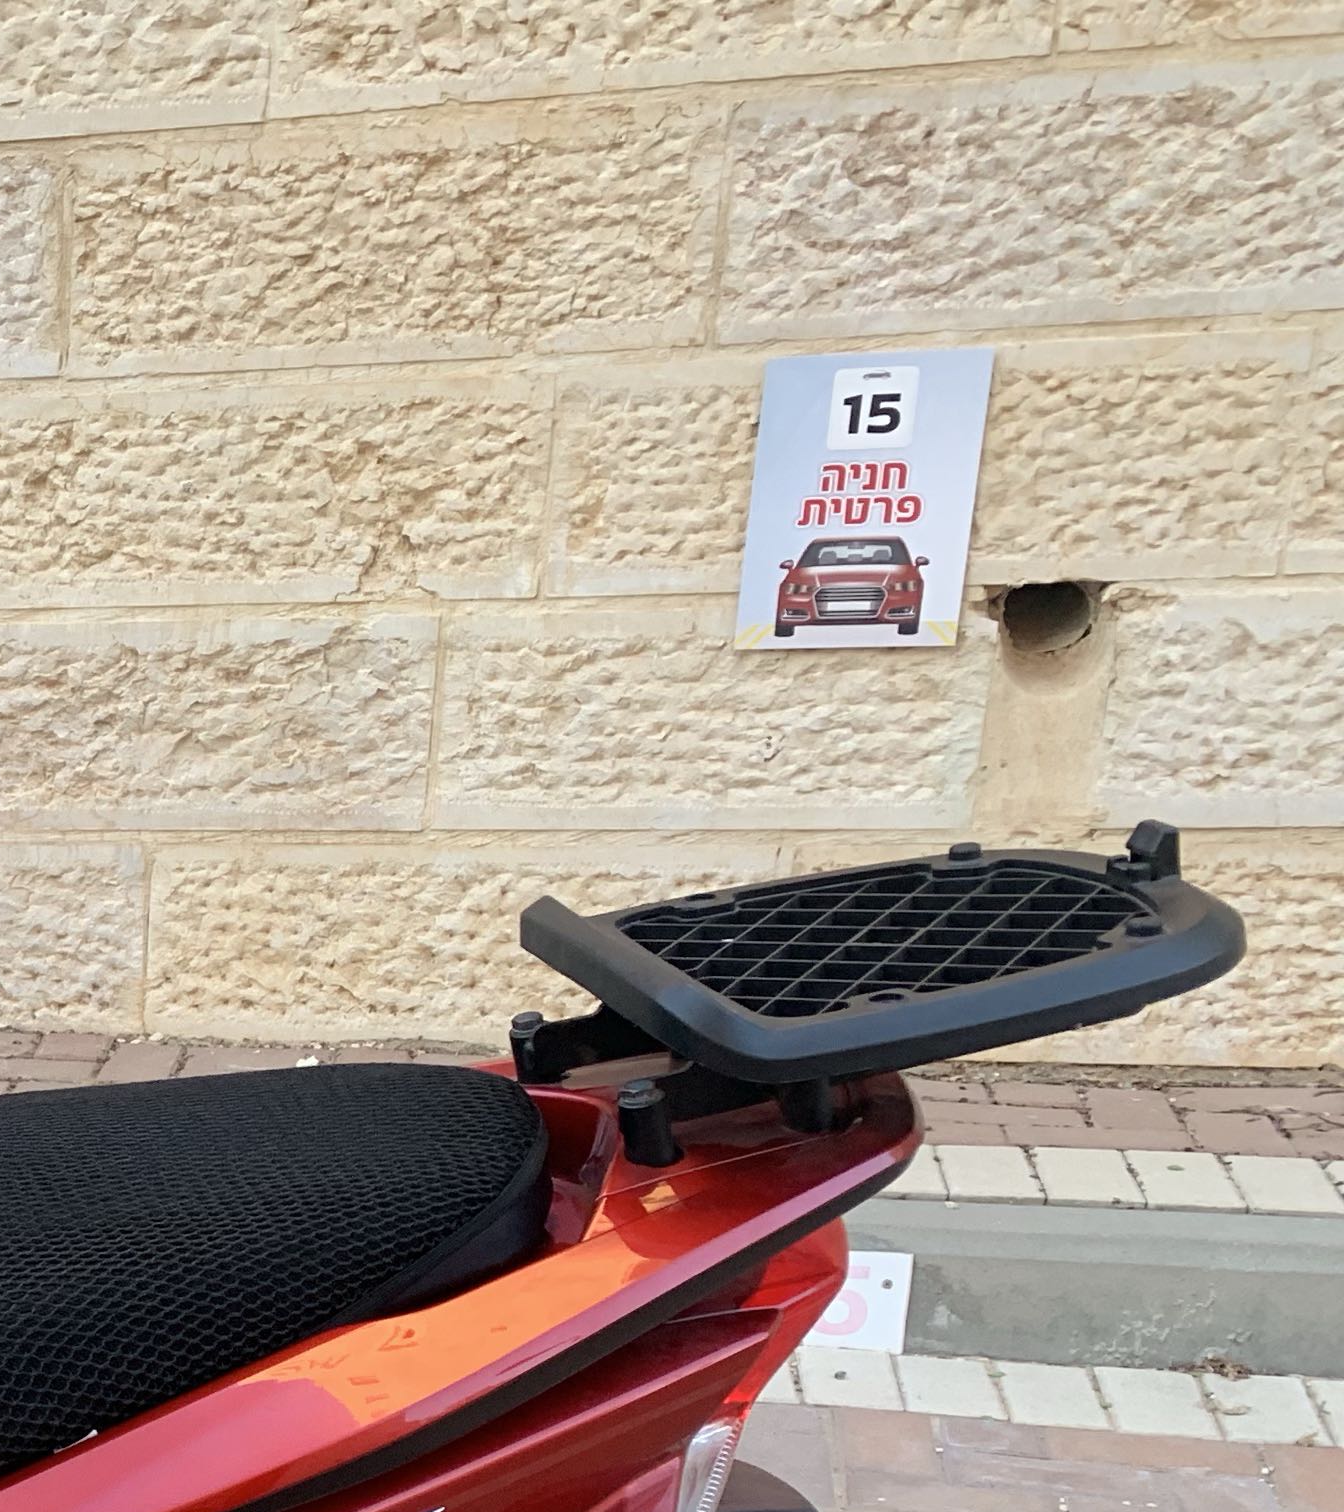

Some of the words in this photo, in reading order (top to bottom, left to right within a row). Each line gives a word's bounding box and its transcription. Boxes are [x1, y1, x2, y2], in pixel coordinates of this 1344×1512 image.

[843, 392, 902, 435] 15
[820, 461, 908, 492] חניה
[796, 495, 922, 526] פרטית
